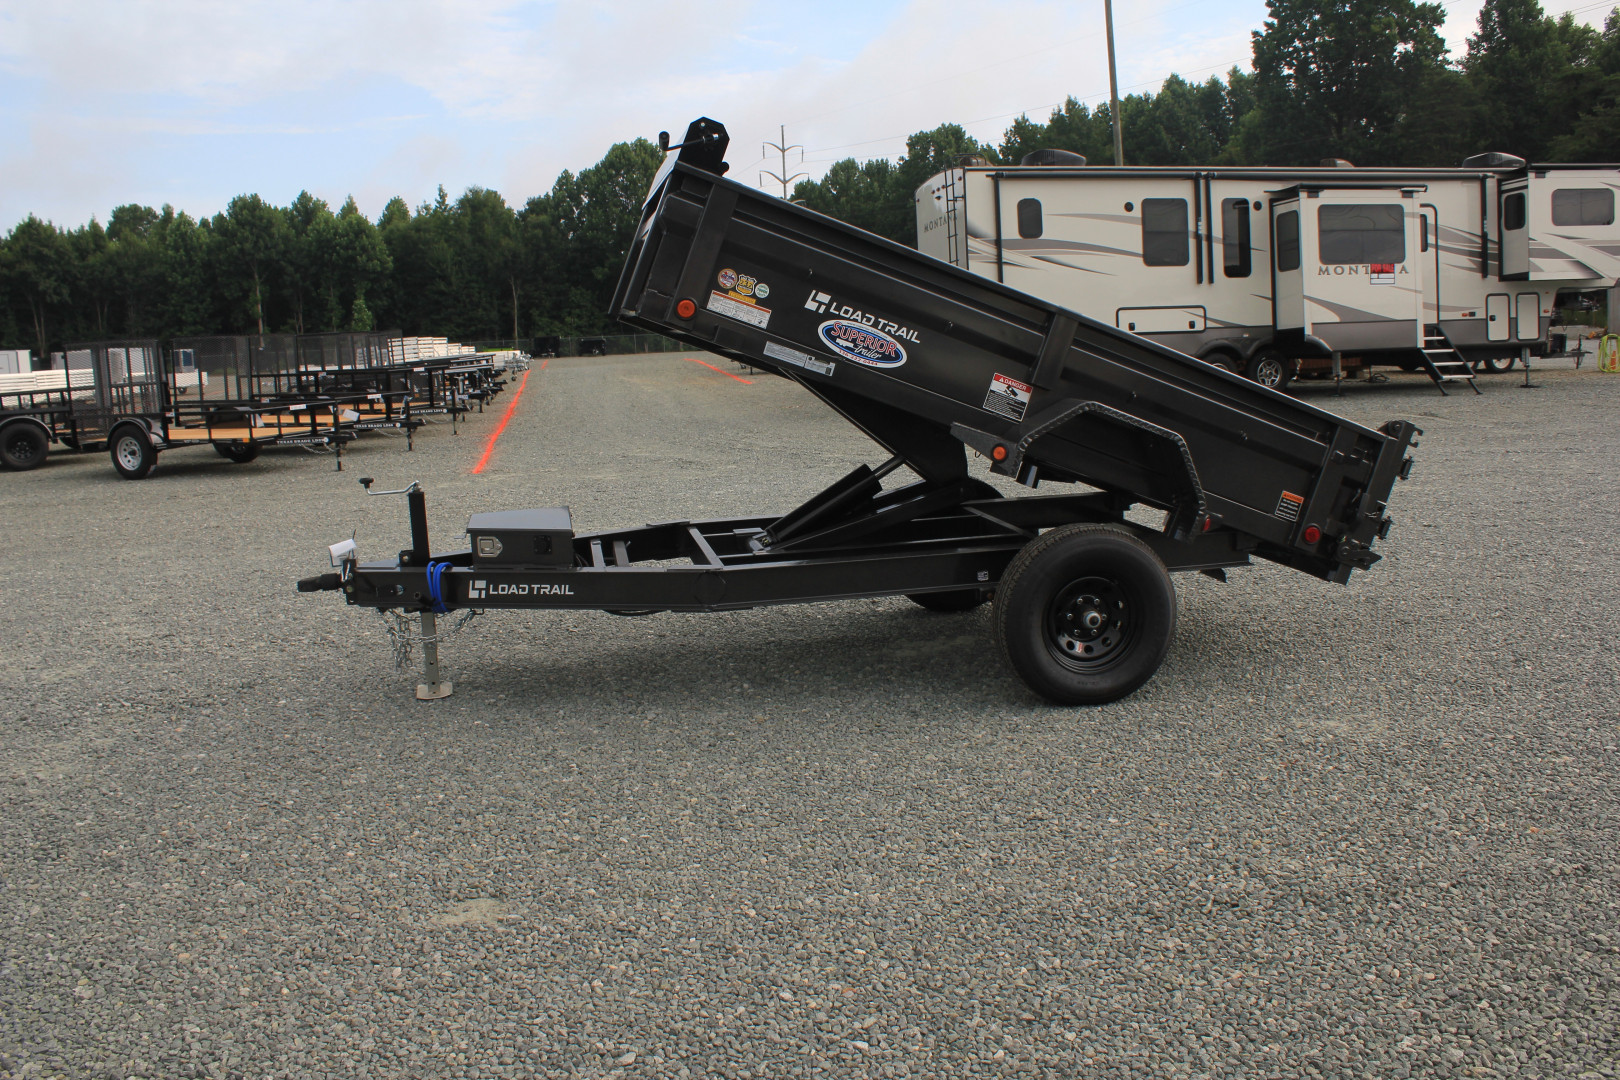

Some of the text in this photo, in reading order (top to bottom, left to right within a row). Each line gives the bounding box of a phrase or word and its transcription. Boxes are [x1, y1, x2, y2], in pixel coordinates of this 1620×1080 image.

[1318, 265, 1409, 276] MONTA
[829, 302, 876, 326] LOAD
[877, 318, 921, 344] TRAIL
[830, 321, 897, 357] SUPERIOR
[1004, 379, 1027, 391] DANGER
[489, 584, 574, 595] LOAD TRAIL
